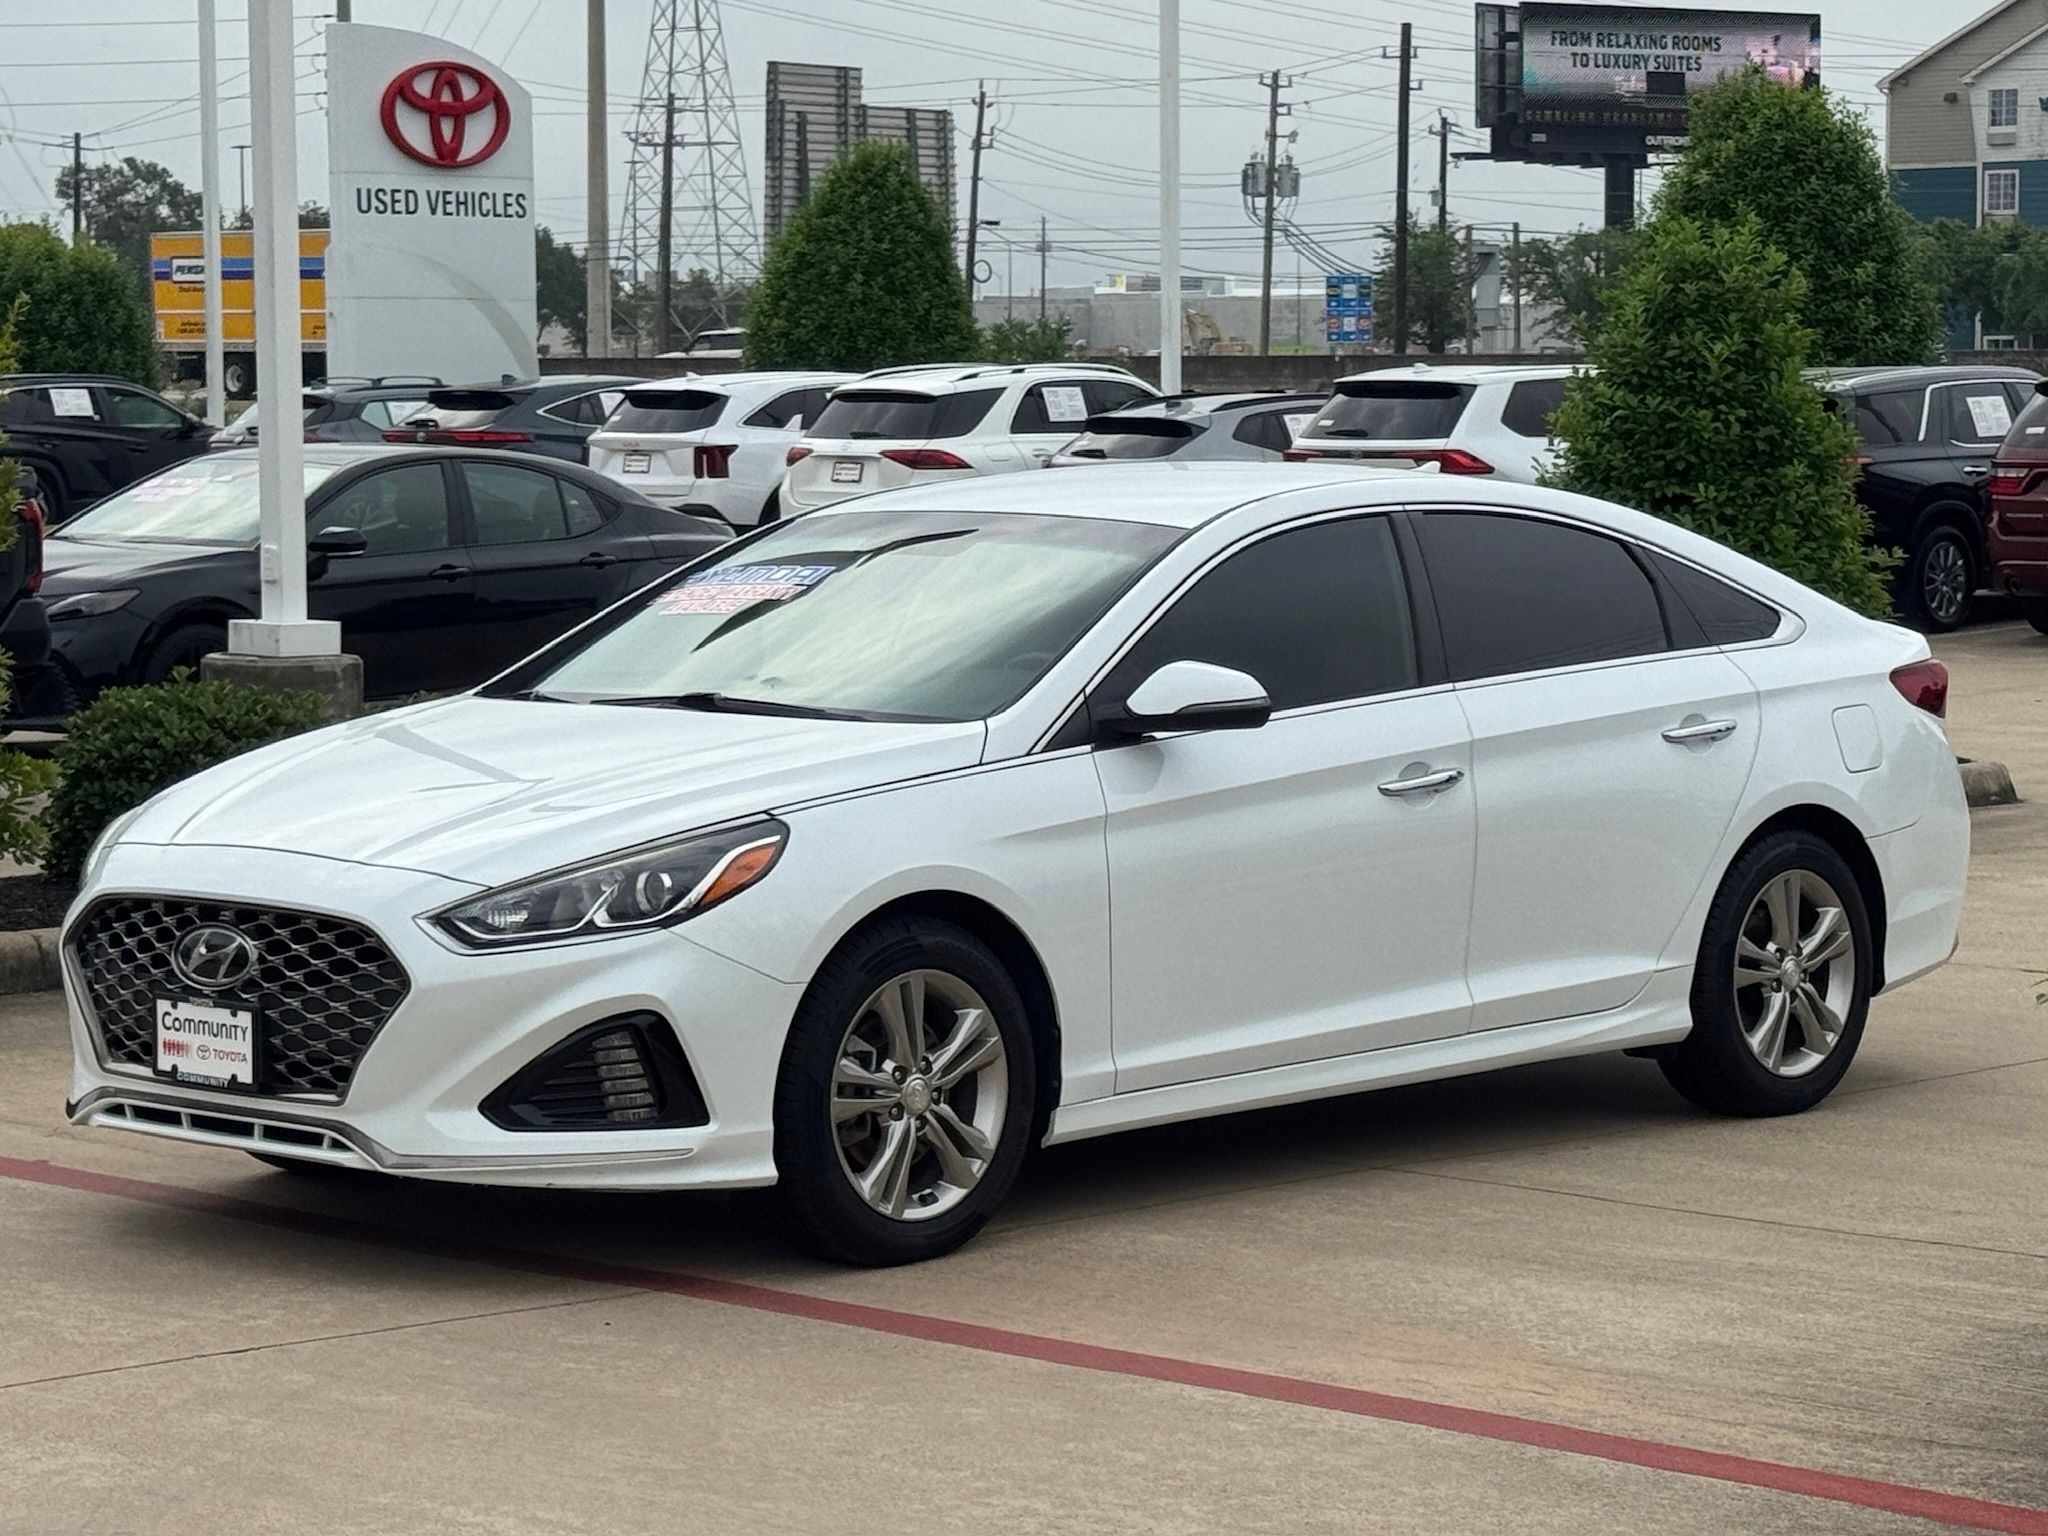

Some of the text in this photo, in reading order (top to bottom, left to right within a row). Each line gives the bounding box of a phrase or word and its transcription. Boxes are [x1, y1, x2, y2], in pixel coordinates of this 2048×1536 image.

[1550, 31, 1722, 52] FROM RELAXING ROOMS
[1570, 52, 1702, 72] TO LUXURY SUITES
[356, 187, 528, 219] USED VEHICLES
[174, 264, 205, 276] PENSK
[213, 1048, 248, 1064] TOYOTA
[177, 1071, 229, 1088] COMMUNITY
